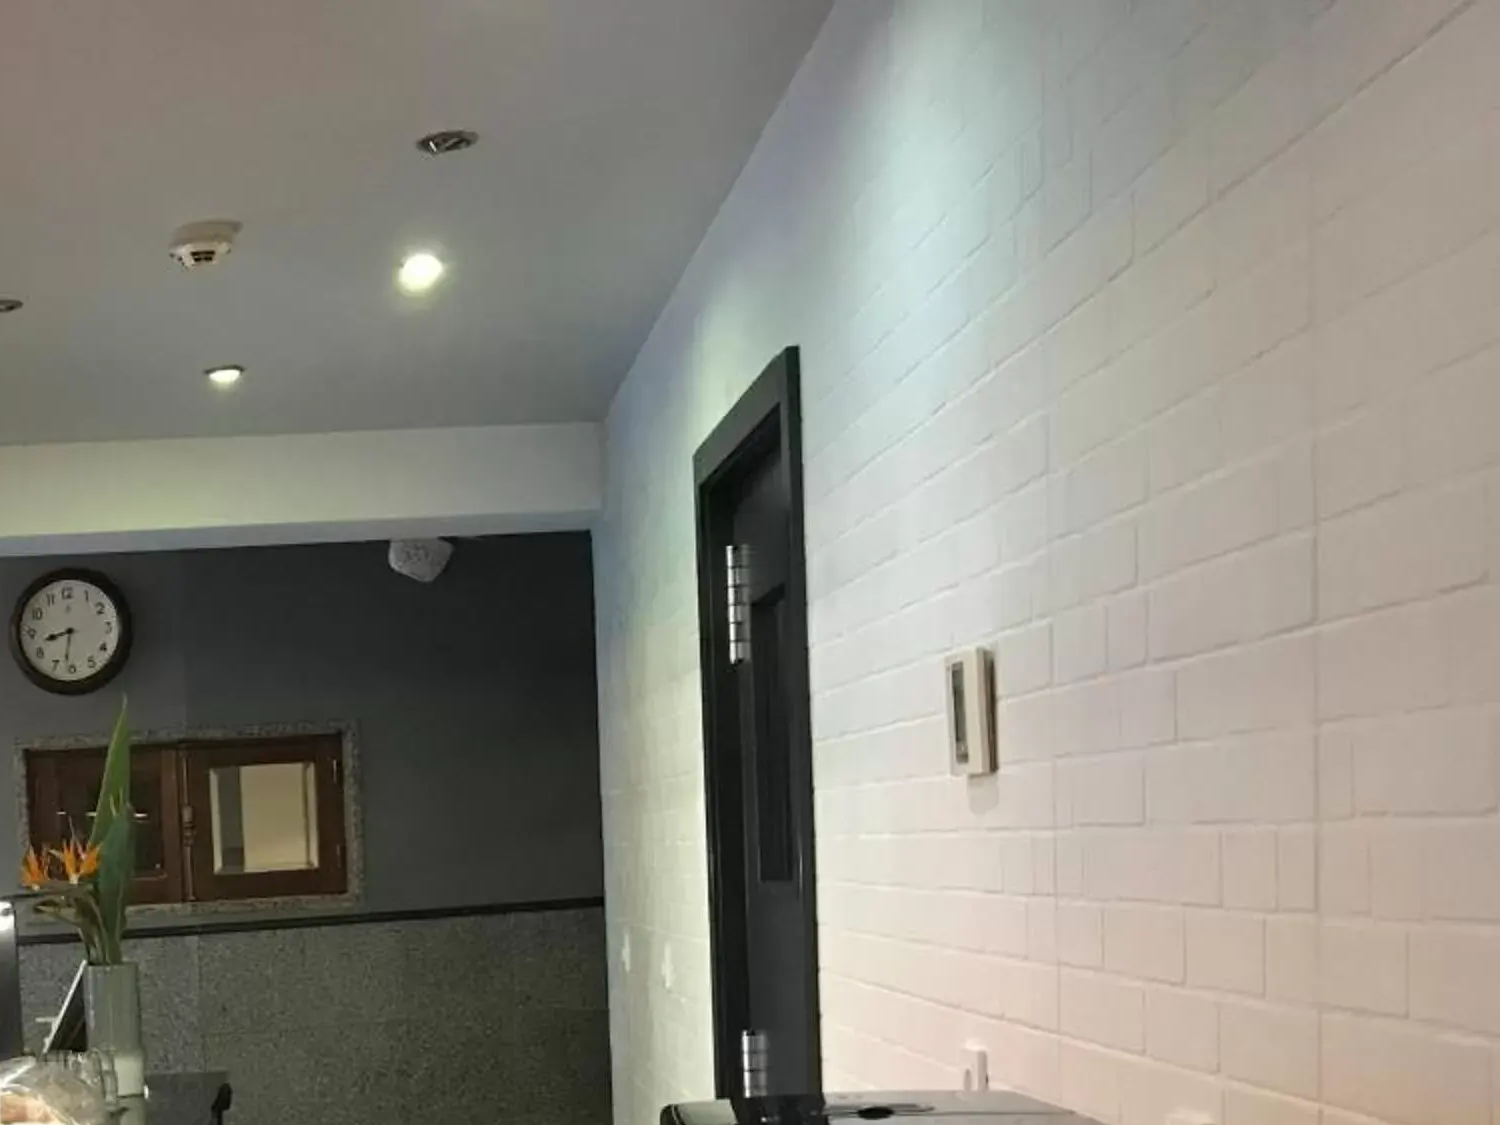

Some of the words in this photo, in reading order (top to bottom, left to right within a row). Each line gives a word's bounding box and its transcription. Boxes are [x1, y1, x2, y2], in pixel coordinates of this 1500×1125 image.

[62, 587, 73, 599] 12
[84, 590, 89, 602] 1
[46, 594, 55, 606] 11
[32, 608, 42, 620] 10
[96, 602, 105, 615] 2
[105, 621, 112, 633] 3
[27, 628, 36, 639] 9
[36, 647, 44, 658] 8
[99, 643, 107, 652] 4
[52, 660, 60, 672] 7
[87, 656, 96, 668] 5
[68, 664, 77, 674] 6
